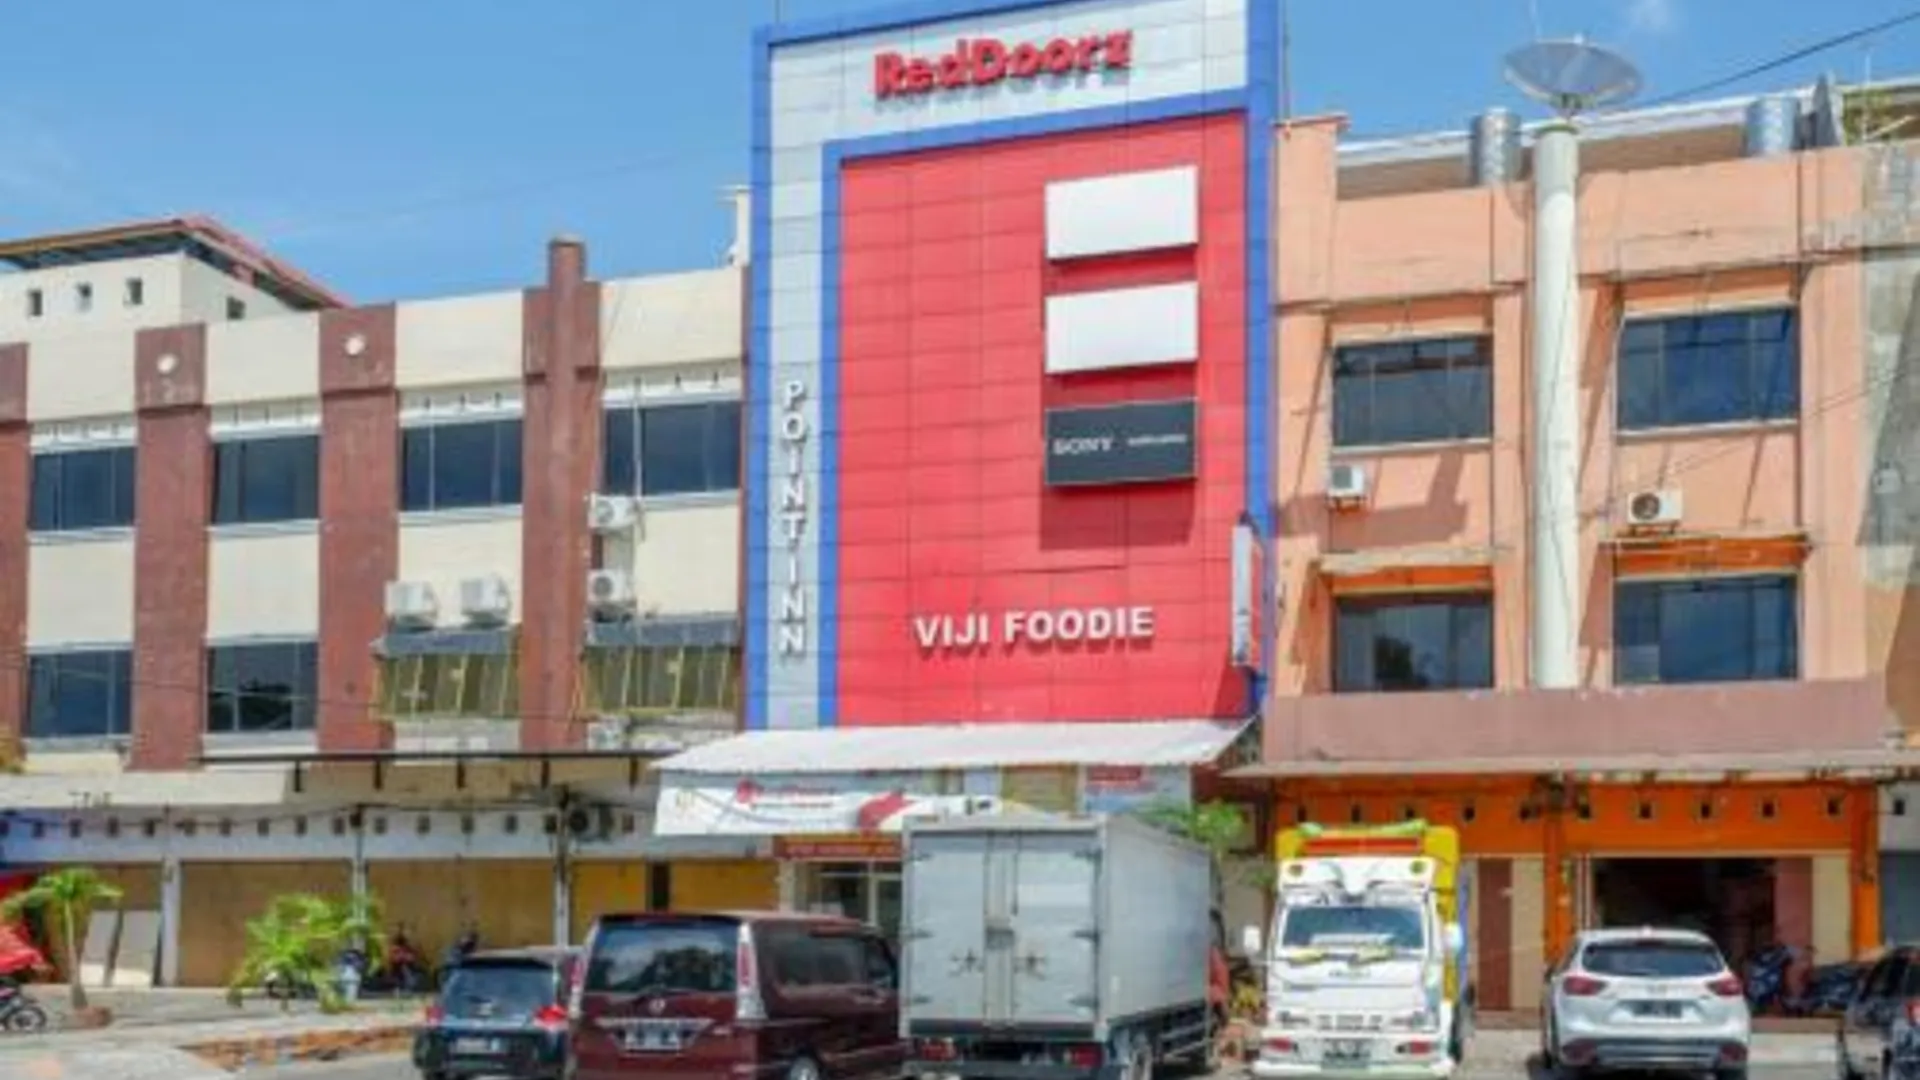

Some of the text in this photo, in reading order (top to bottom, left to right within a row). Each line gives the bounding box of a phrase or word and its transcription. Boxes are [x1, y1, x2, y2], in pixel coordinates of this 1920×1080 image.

[874, 29, 1132, 98] RedDoorz
[1053, 436, 1114, 455] SONY
[914, 606, 1153, 647] VIJI FOODIE
